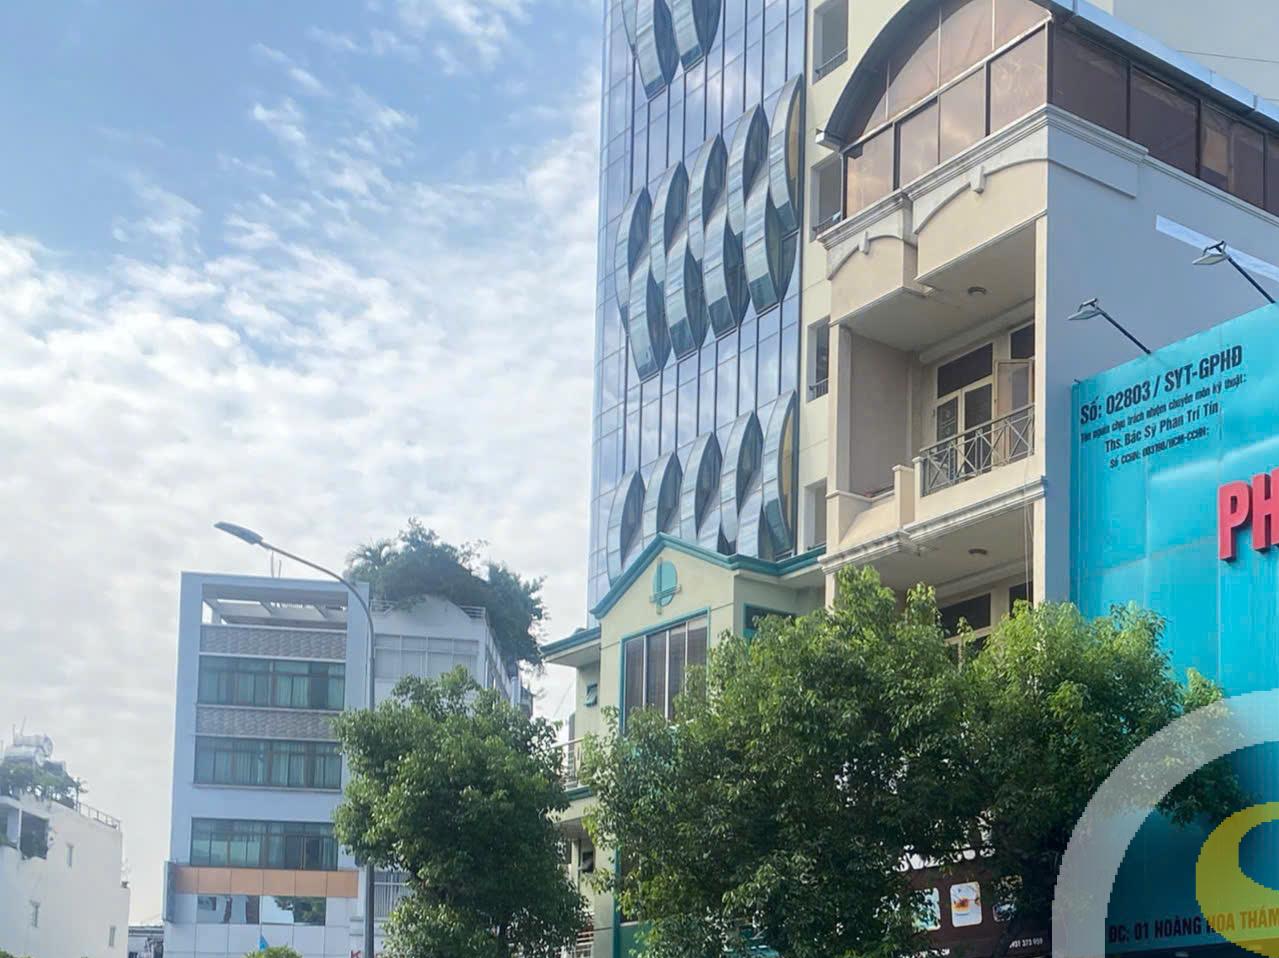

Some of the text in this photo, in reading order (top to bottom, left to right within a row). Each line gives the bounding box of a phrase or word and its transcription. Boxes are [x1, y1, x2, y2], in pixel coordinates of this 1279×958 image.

[1106, 380, 1151, 415] 02803
[1164, 345, 1243, 392] SYT-GPHĐ
[1160, 415, 1184, 434] Phan
[1134, 922, 1150, 940] 01
[1154, 911, 1202, 940] HOÀNG
